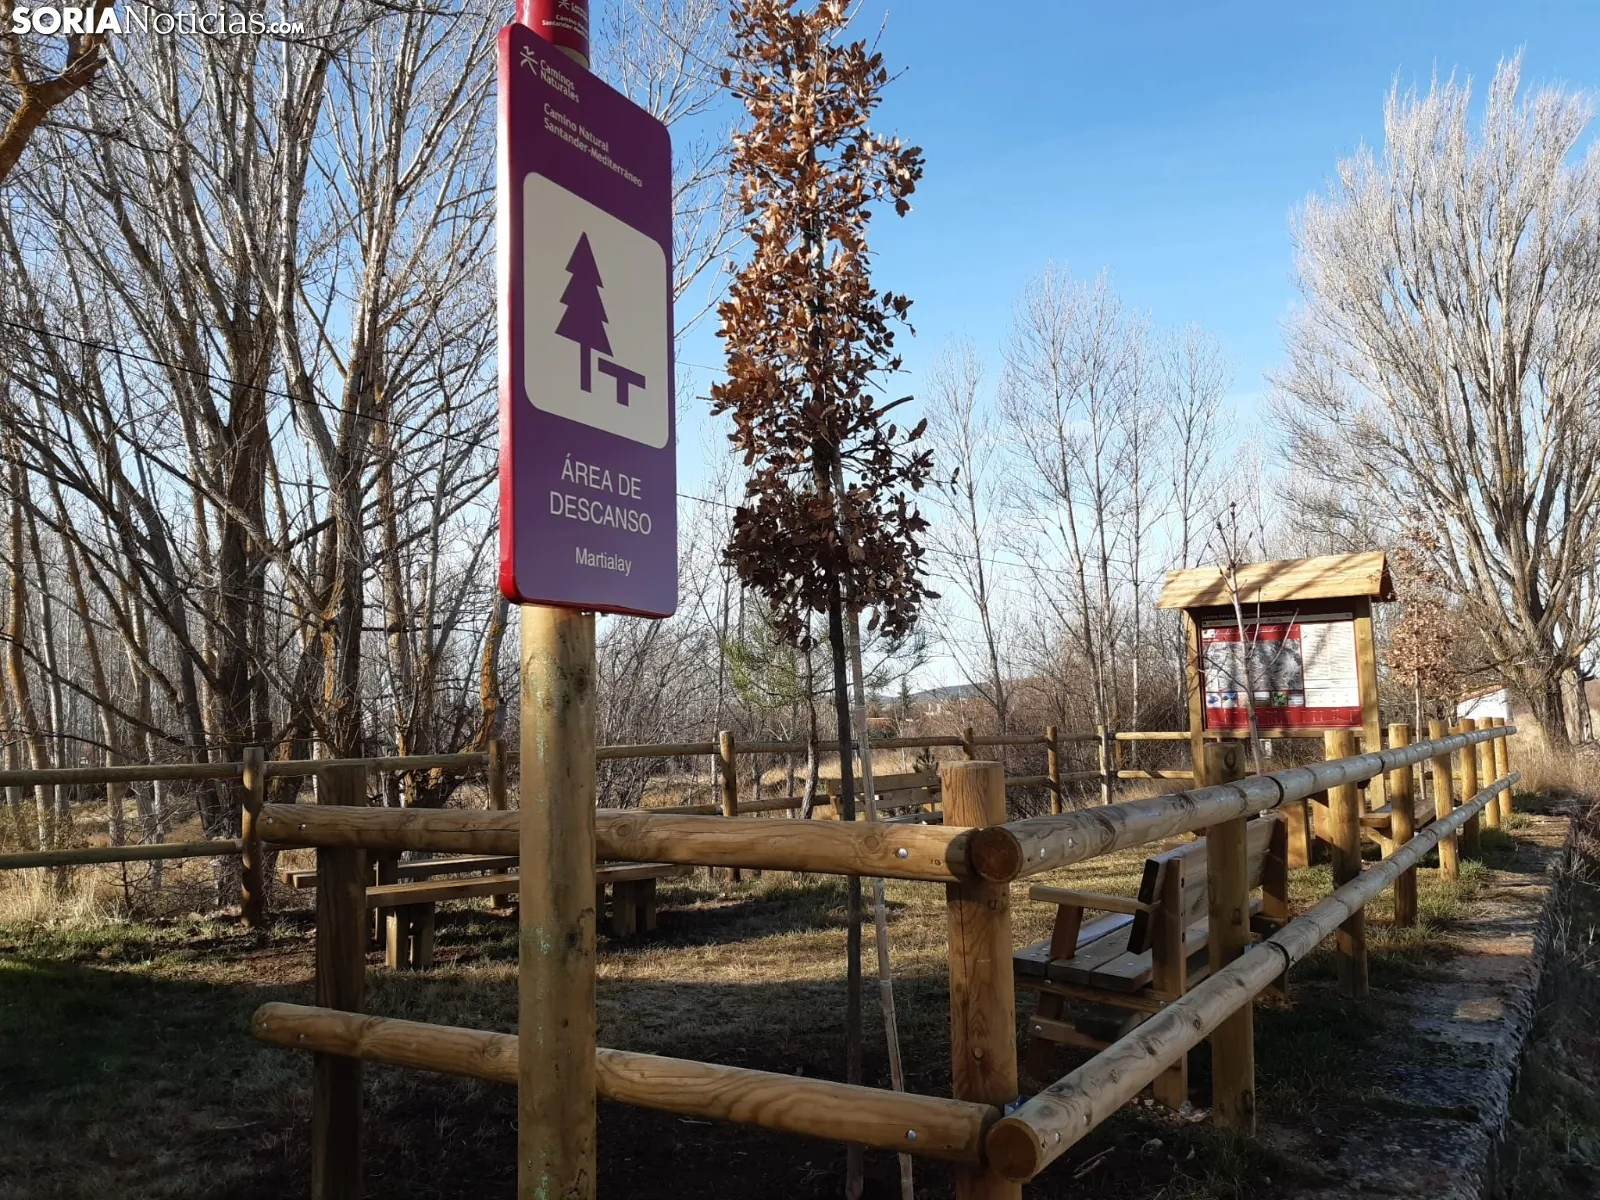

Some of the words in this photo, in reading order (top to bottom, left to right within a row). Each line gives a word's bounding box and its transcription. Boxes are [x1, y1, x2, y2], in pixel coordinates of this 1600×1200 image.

[540, 59, 575, 91] Caminos
[540, 73, 580, 103] Naturales
[543, 102, 577, 132] Camino
[579, 124, 609, 153] Natural
[561, 452, 613, 493] ÁREA
[618, 473, 642, 500] DE
[550, 490, 652, 535] DESCANSO
[575, 546, 632, 577] Martialay
